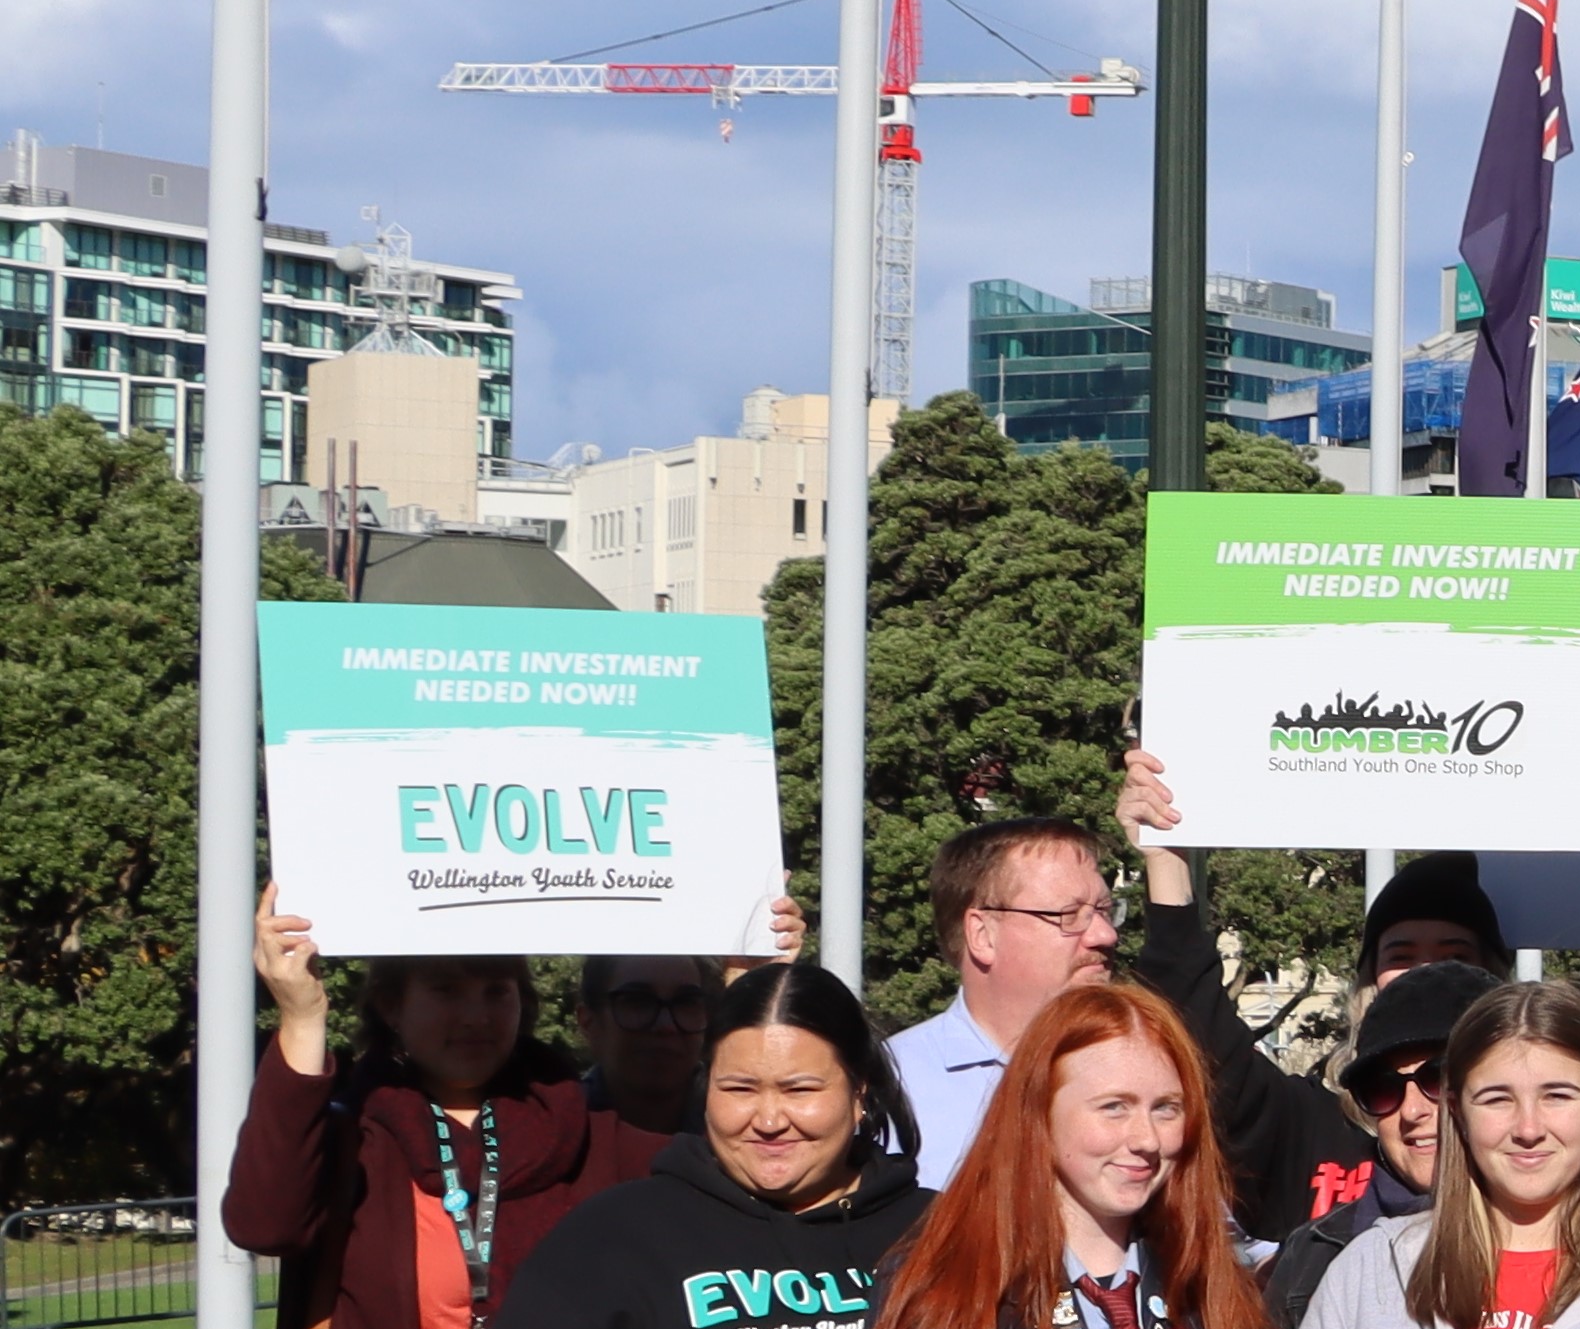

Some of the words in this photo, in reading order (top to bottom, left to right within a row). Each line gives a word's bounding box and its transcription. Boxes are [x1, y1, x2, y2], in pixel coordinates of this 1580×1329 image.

[1550, 289, 1576, 301] Kiwi
[1216, 541, 1385, 566] IMMEDIATE
[1392, 543, 1580, 571] INVESTMENT
[1283, 574, 1401, 599] NEEDED
[1408, 575, 1510, 602] NOW!!
[342, 647, 511, 674] IMMEDIATE
[520, 650, 702, 679] INVESTMENT
[414, 679, 532, 704] NEEDED
[540, 681, 637, 707] NOW!!
[1270, 728, 1450, 755] NUMBER
[1451, 699, 1525, 756] 10
[1268, 757, 1347, 773] Southland
[1353, 758, 1399, 773] Youth
[1405, 759, 1437, 774] One
[1443, 760, 1479, 777] Stop
[1484, 761, 1525, 778] Shop
[397, 783, 672, 857] EVOLVE
[408, 868, 527, 893] Wellington
[531, 867, 598, 893] Youth
[602, 868, 675, 890] Service
